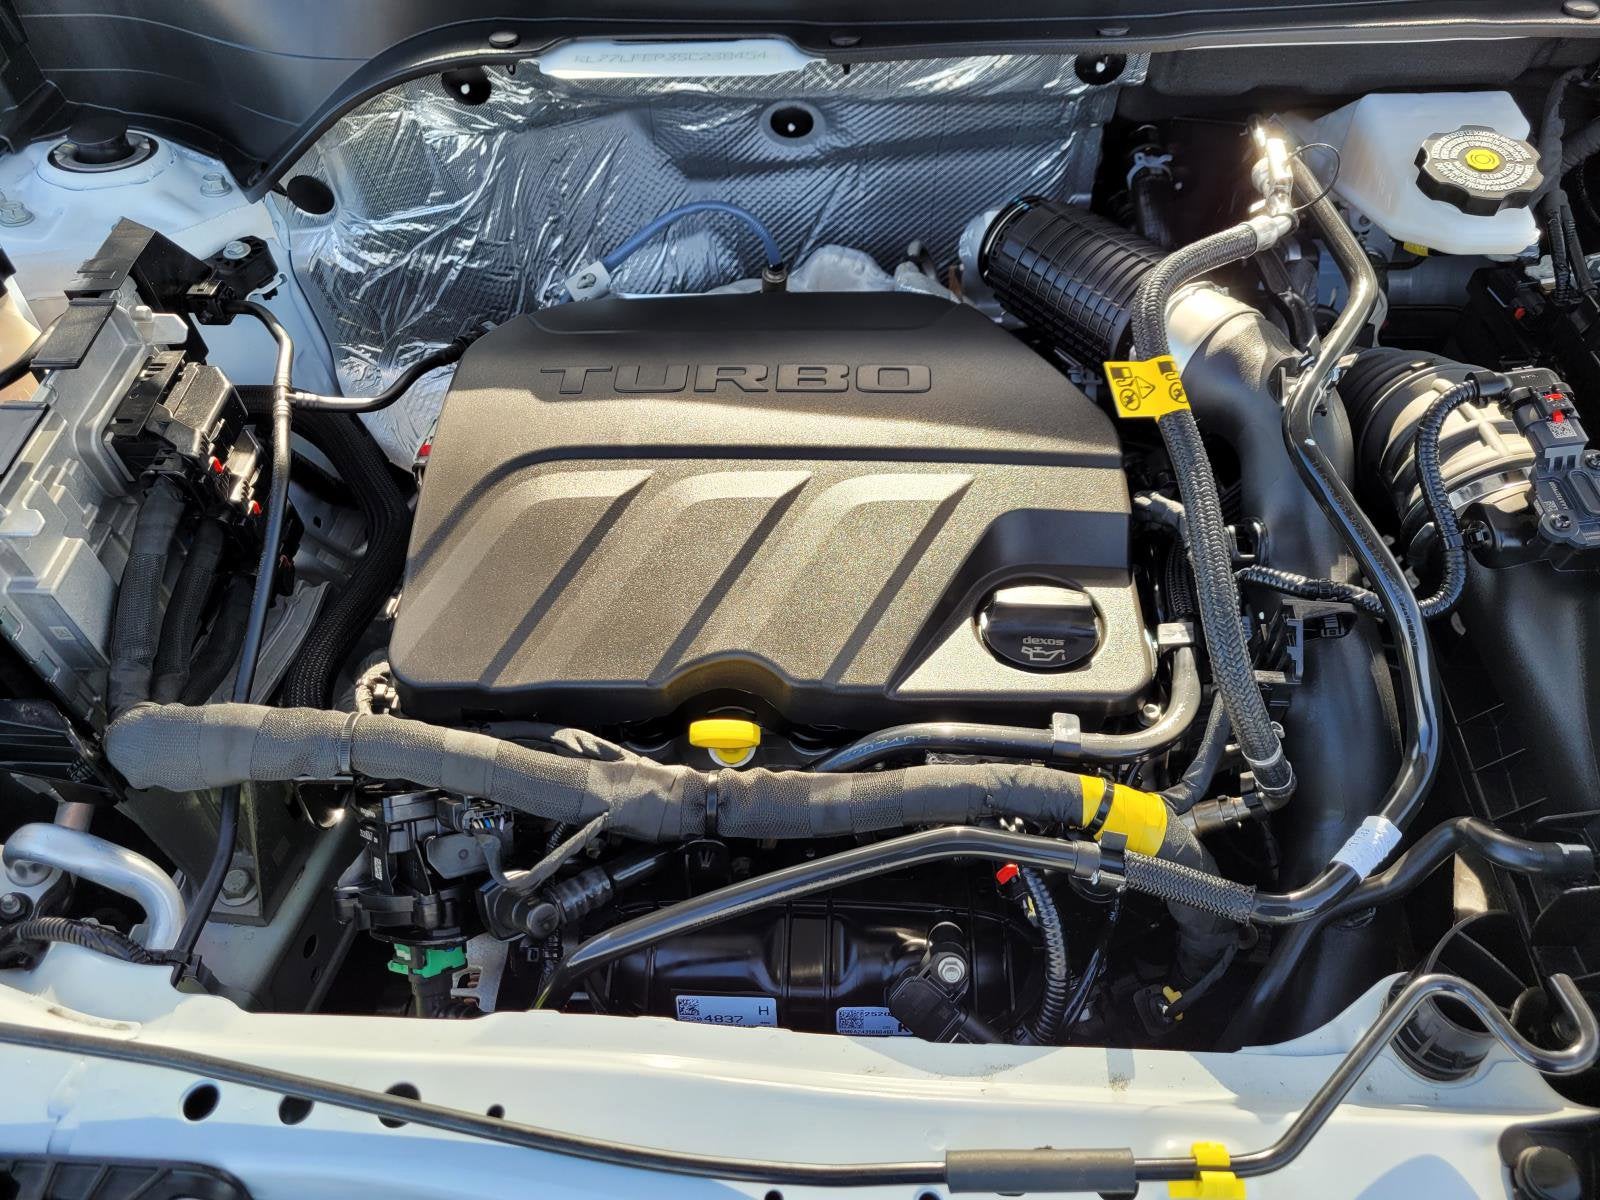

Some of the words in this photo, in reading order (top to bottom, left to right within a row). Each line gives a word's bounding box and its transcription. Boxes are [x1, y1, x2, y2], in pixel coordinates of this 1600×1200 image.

[540, 364, 932, 394] TURBO
[1022, 636, 1066, 646] dexos
[758, 1005, 769, 1016] H
[704, 1014, 744, 1024] 4837
